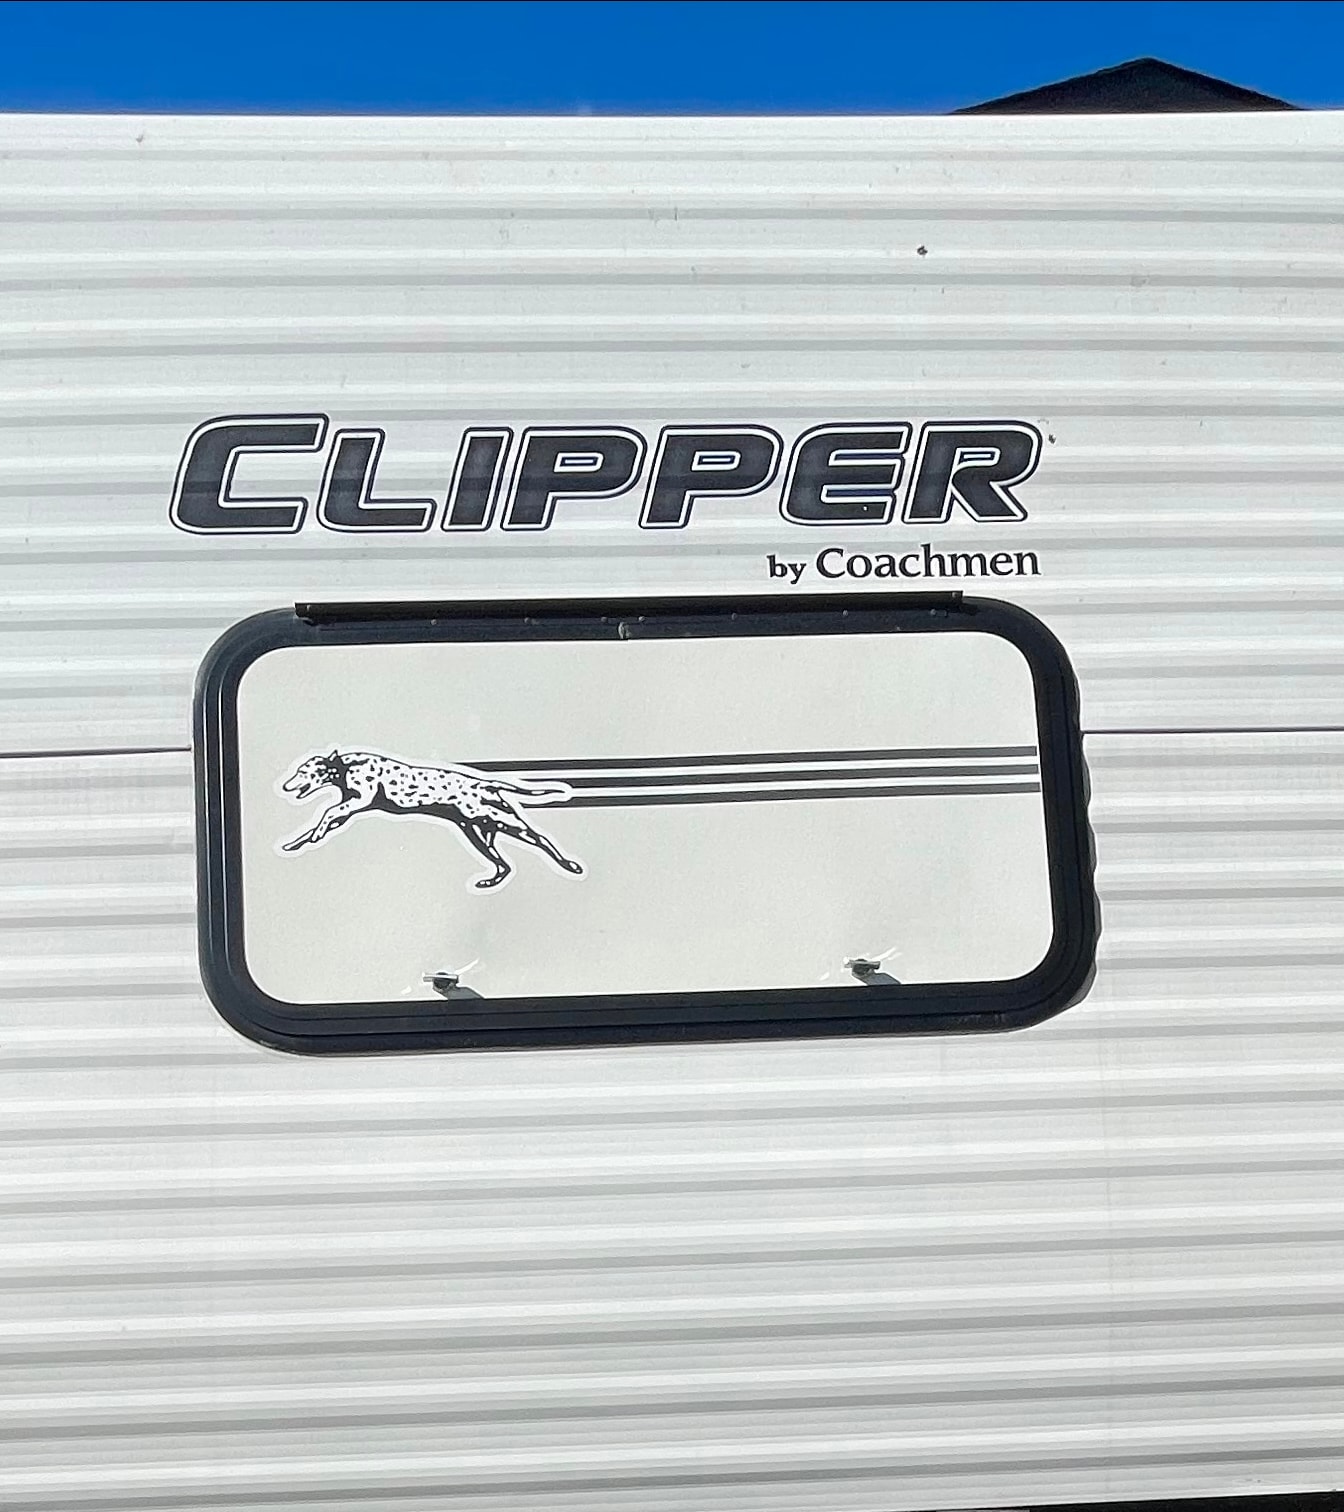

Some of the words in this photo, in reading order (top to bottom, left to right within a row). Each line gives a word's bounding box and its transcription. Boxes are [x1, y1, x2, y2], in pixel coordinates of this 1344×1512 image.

[168, 413, 1043, 534] CLIPPER
[766, 554, 806, 584] by
[816, 543, 1041, 578] Coachmen
